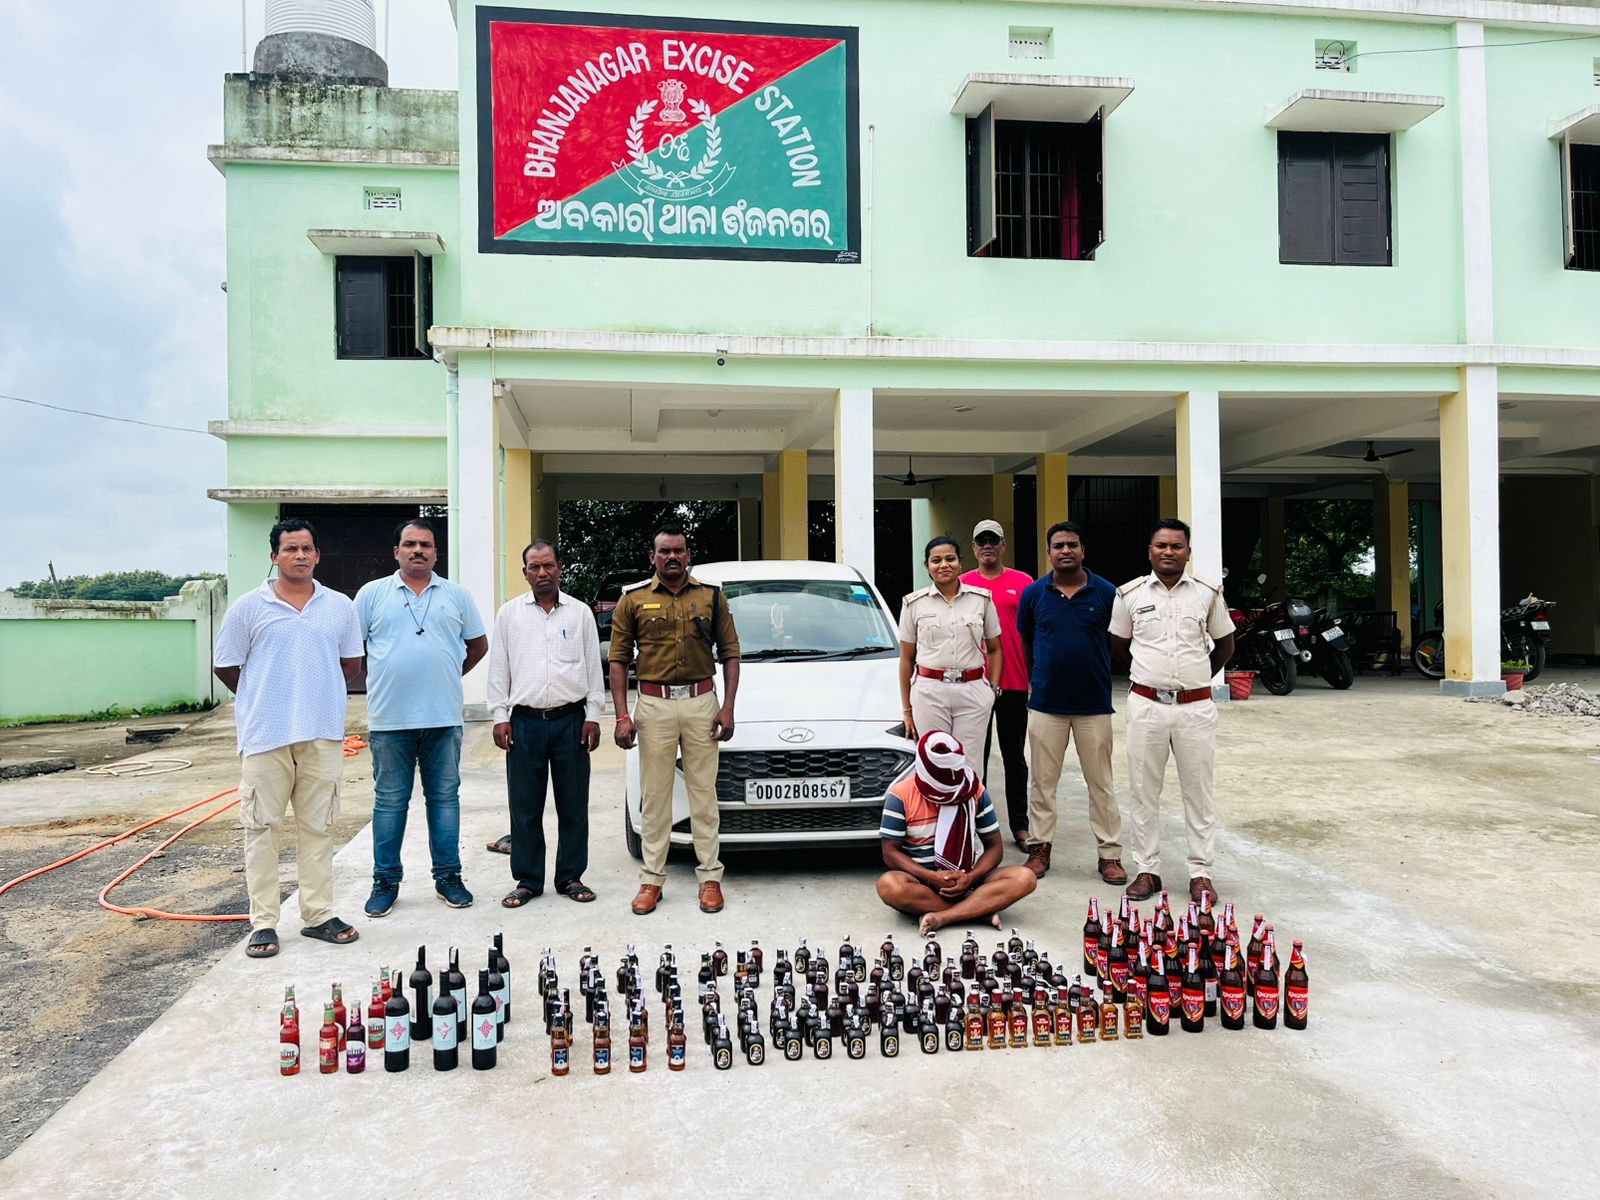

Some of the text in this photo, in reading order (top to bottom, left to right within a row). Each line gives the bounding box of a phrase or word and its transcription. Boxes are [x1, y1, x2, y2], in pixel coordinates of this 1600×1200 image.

[523, 39, 822, 188] BHANJANAGAR EXCISE STATION
[658, 203, 717, 236] ଥାନା
